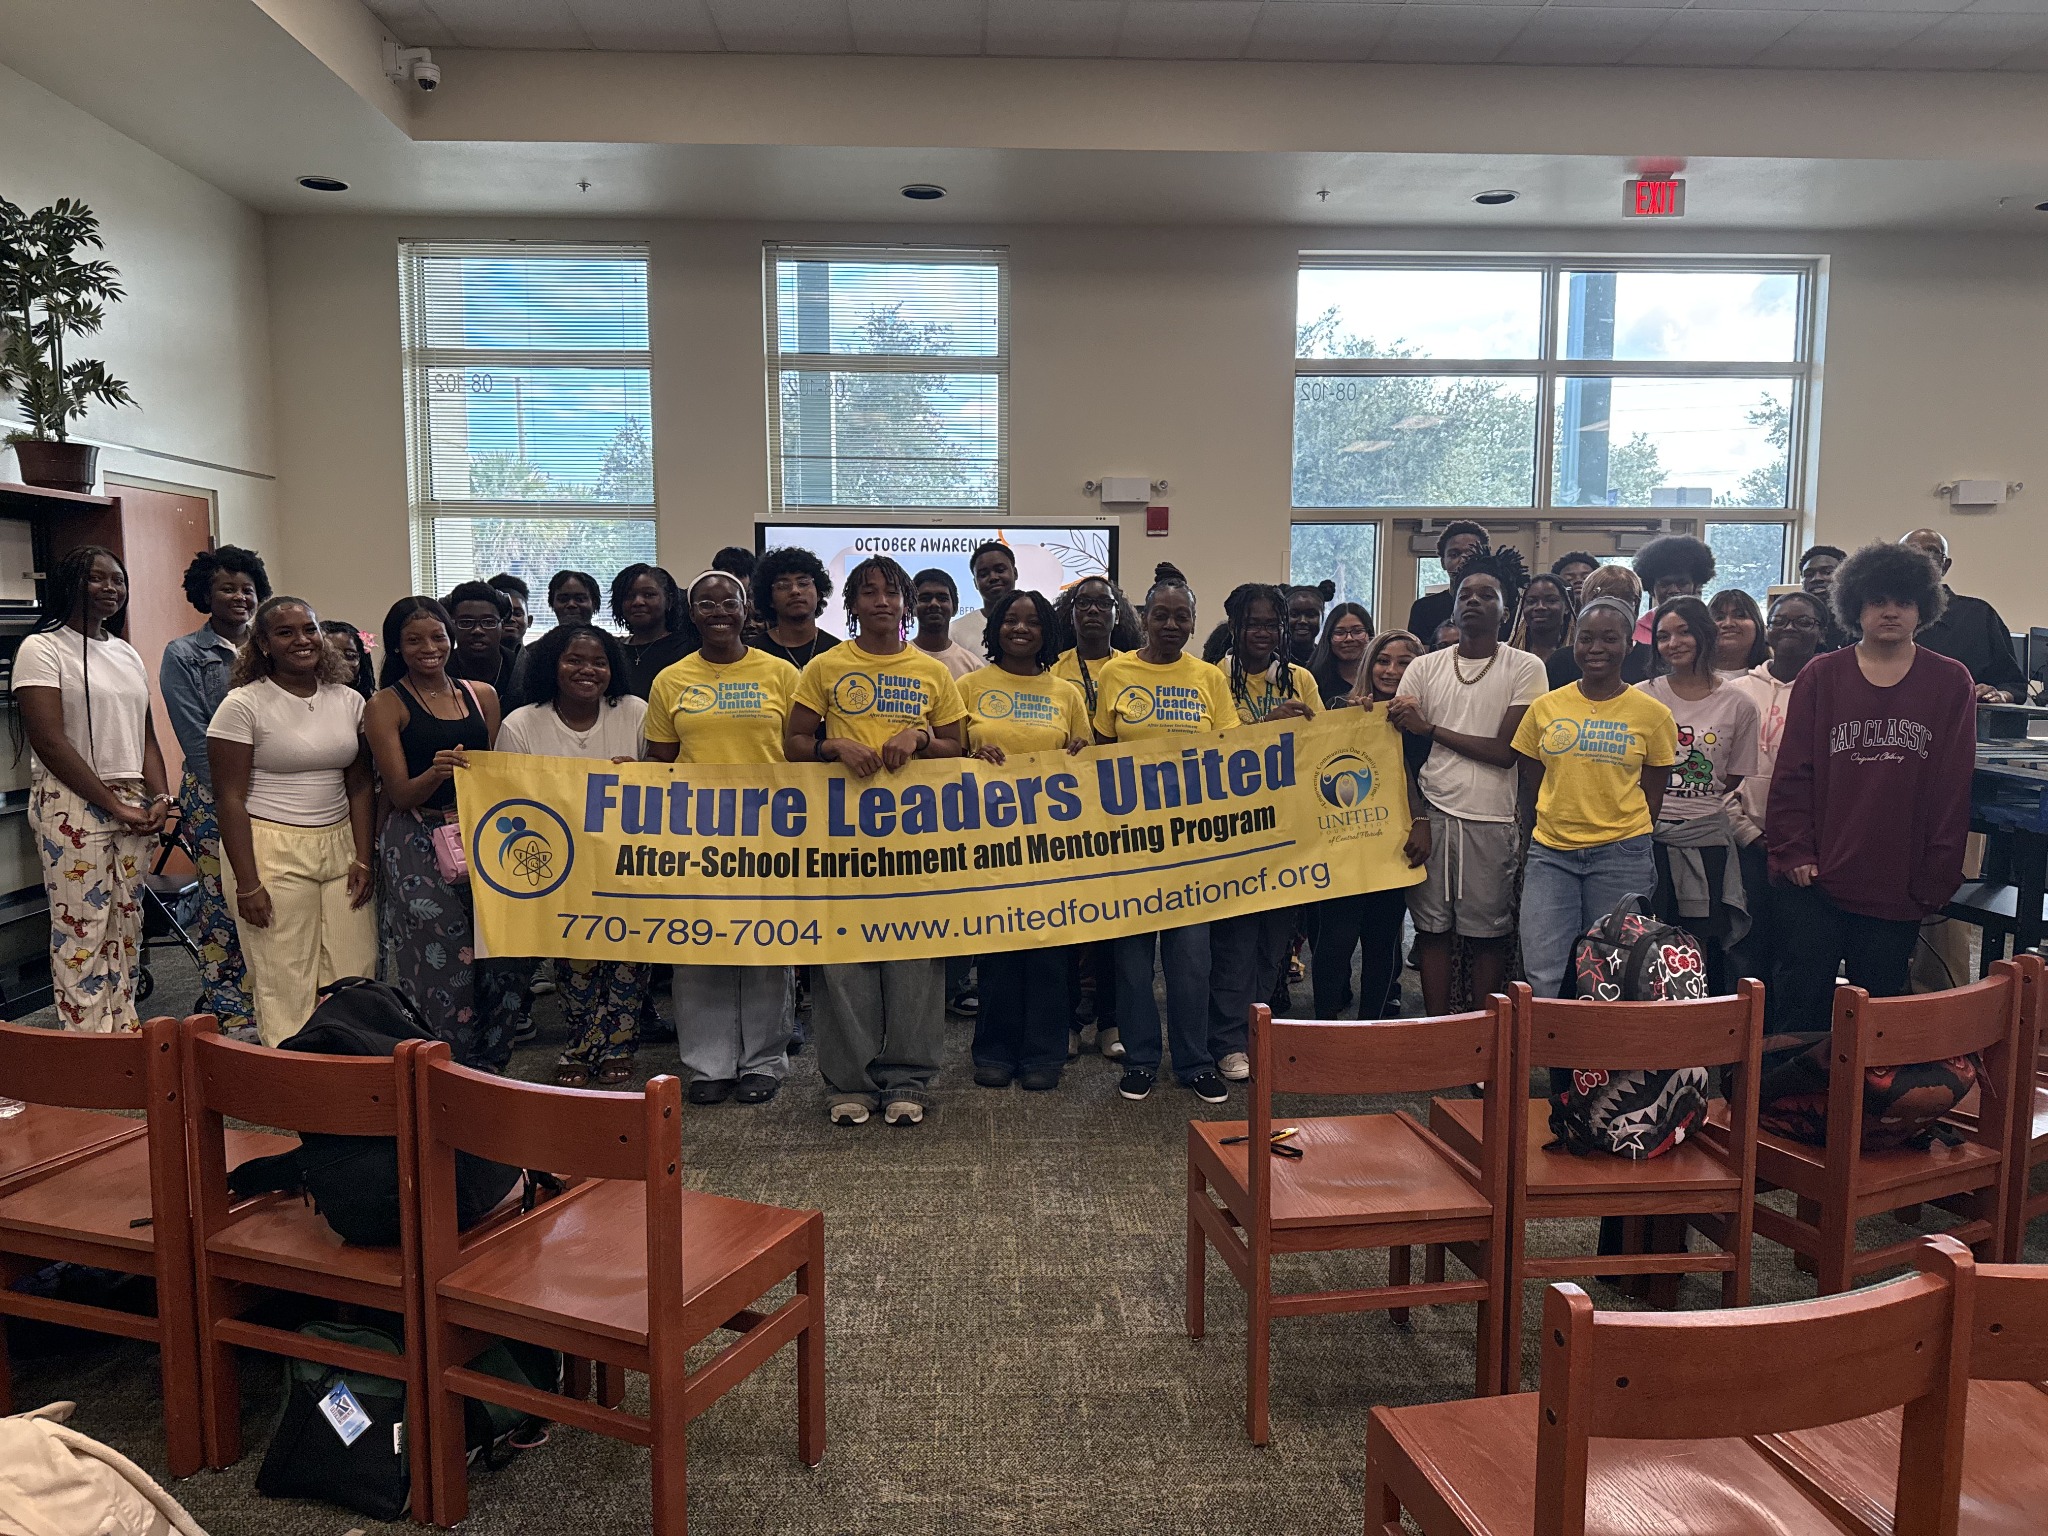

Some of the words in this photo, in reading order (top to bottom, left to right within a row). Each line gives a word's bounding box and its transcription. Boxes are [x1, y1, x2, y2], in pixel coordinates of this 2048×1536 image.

[1635, 181, 1679, 215] EXIT
[855, 537, 916, 552] OCTOBER
[920, 537, 1002, 553] AWAREN
[718, 682, 759, 691] Future
[877, 673, 921, 690] Future
[718, 690, 768, 700] Leaders
[877, 686, 929, 706] Leaders
[1014, 691, 1051, 704] Future
[1155, 685, 1199, 699] Future
[718, 699, 762, 709] United
[876, 698, 921, 716] United
[1014, 701, 1060, 716] Leaders
[1155, 697, 1206, 714] Leaders
[1014, 709, 1053, 721] United
[1156, 708, 1201, 722] United
[1582, 718, 1628, 731] Future
[1580, 728, 1636, 746] Leaders
[1579, 739, 1627, 756] United
[584, 772, 808, 837] Future
[828, 772, 1082, 837] Leaders
[1096, 732, 1297, 816] United
[1317, 806, 1389, 830] UNITED
[615, 844, 800, 878] After-School
[806, 843, 968, 878] Enrichment
[973, 836, 1023, 870] and
[1026, 824, 1166, 865] Mentoring
[1169, 805, 1277, 847] Program
[557, 913, 823, 946] 770-789-7004
[860, 861, 1332, 943] www.unitedfoundationcf.org
